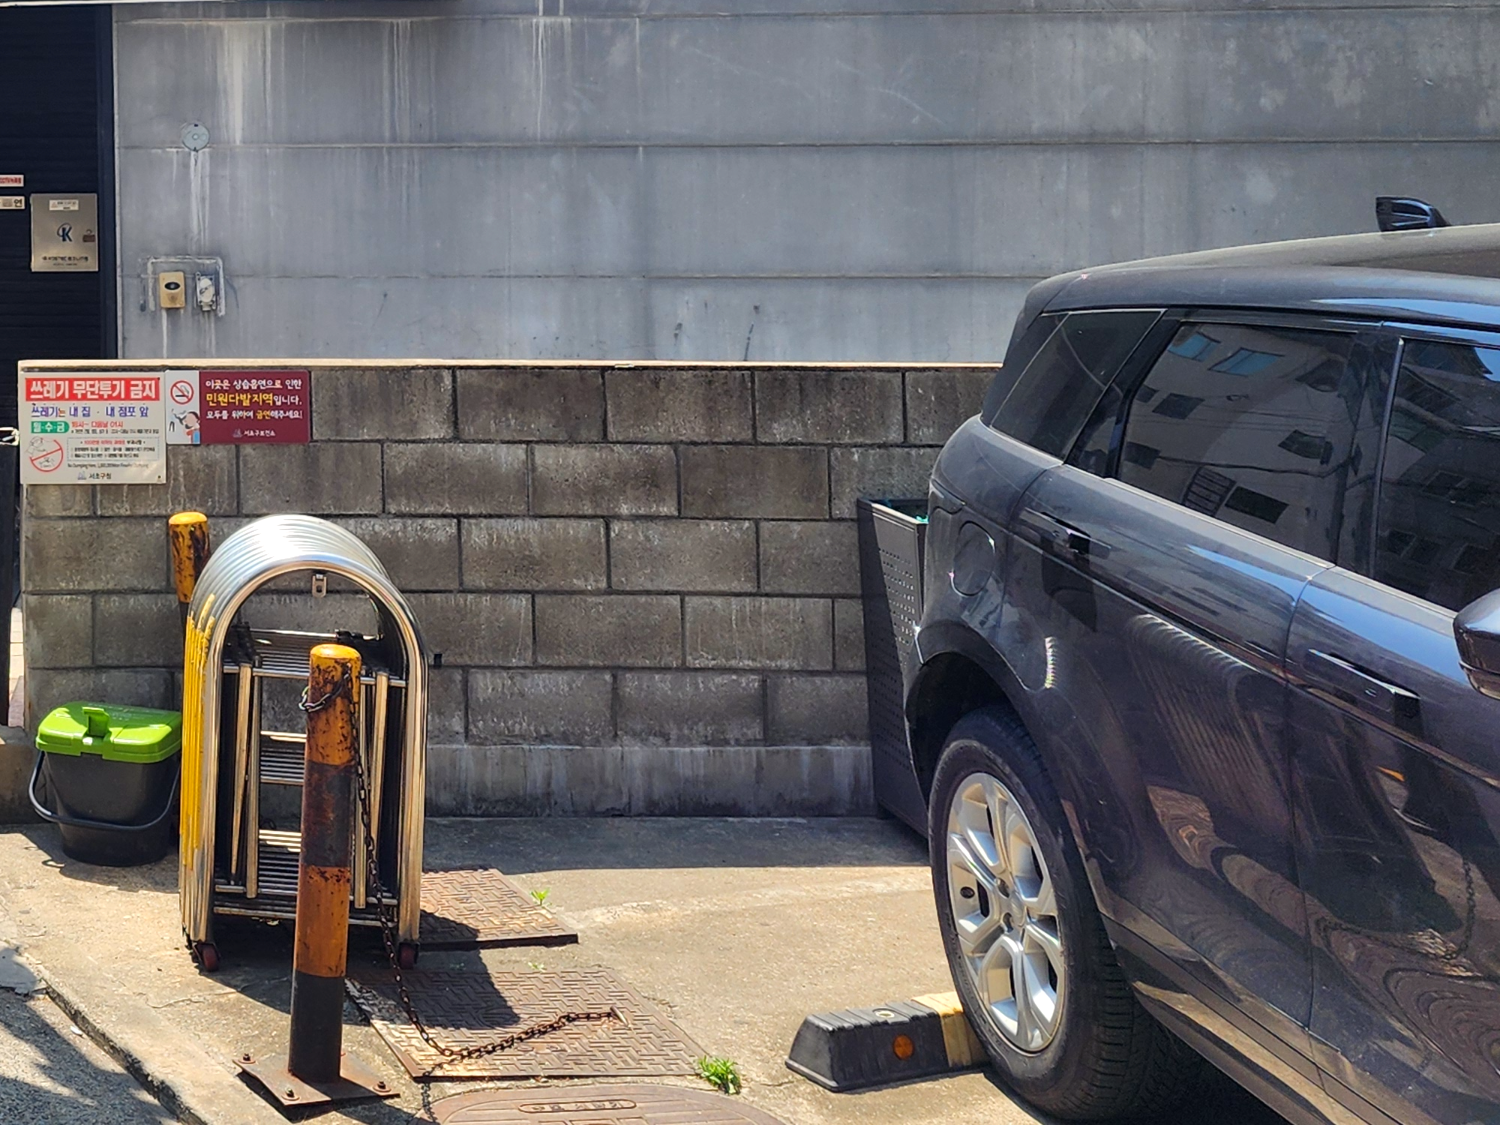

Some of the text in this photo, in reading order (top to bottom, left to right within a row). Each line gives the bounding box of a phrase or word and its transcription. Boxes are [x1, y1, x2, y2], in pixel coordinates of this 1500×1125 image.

[30, 380, 156, 399] 쓰레기 무단투기 금지
[205, 379, 231, 390] 이곳은
[285, 379, 302, 390] 인한
[31, 406, 66, 418] 쓰레기는
[69, 406, 79, 417] 내
[105, 406, 115, 417] 내
[139, 406, 149, 417] 앞
[206, 410, 229, 420] 모두를
[231, 410, 254, 420] 위하여
